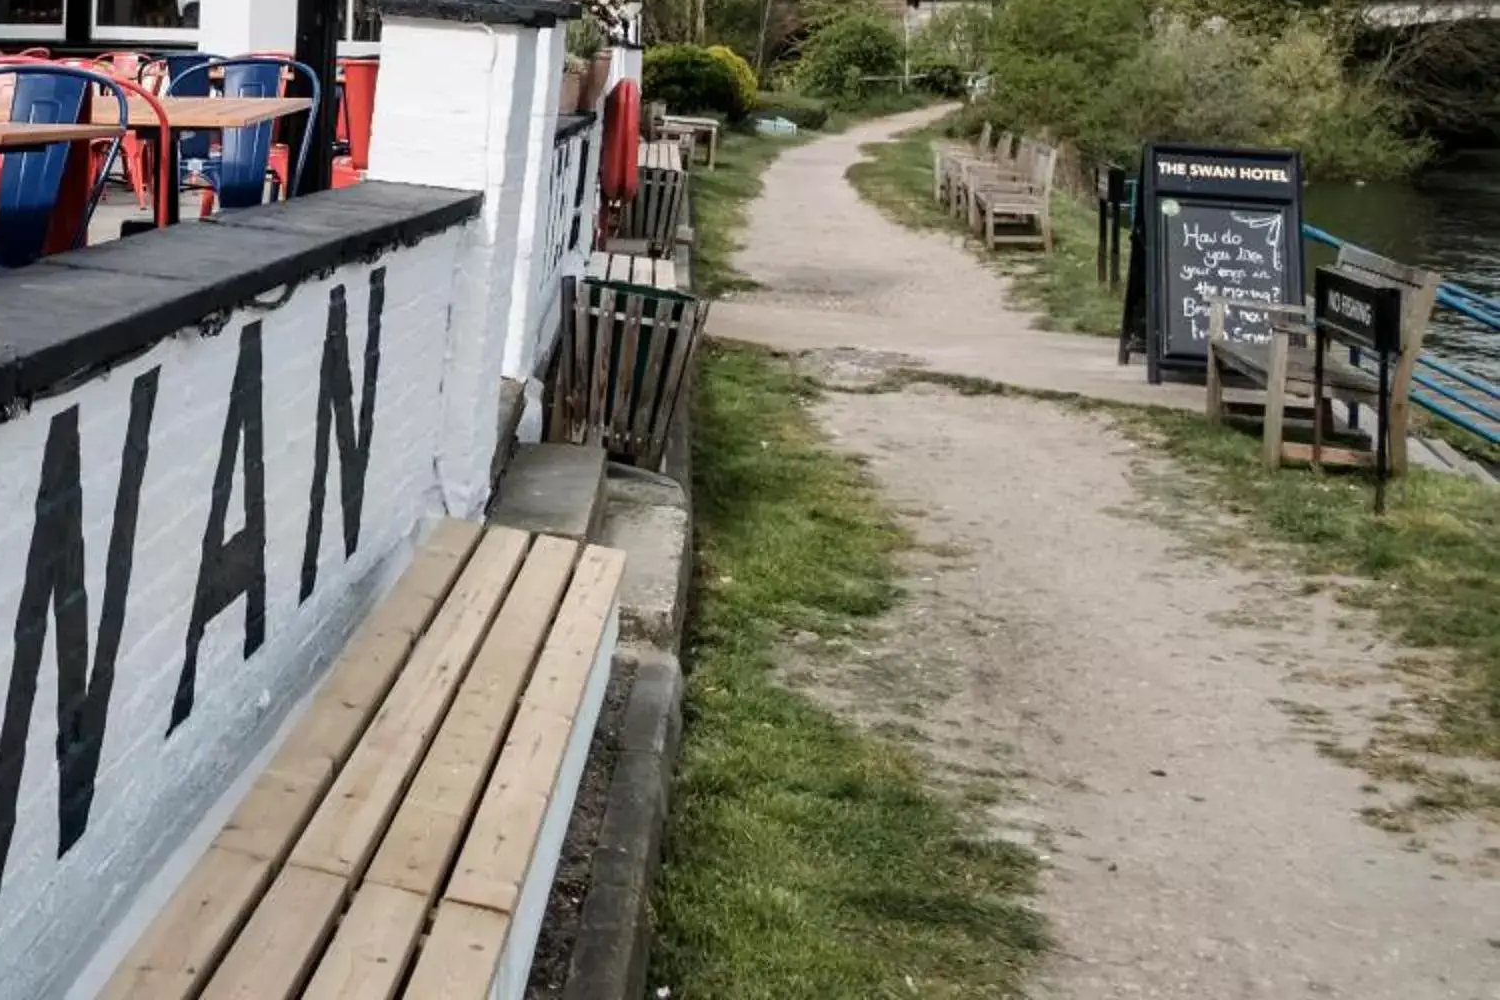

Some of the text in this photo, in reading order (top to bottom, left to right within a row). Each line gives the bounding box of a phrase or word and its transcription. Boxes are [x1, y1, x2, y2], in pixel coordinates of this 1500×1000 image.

[1157, 161, 1290, 183] THE SWAN HOTEL
[1221, 228, 1242, 245] do
[1203, 250, 1230, 268] you
[1180, 265, 1209, 280] your
[1194, 281, 1218, 300] the
[1328, 290, 1372, 327] NO FISHING
